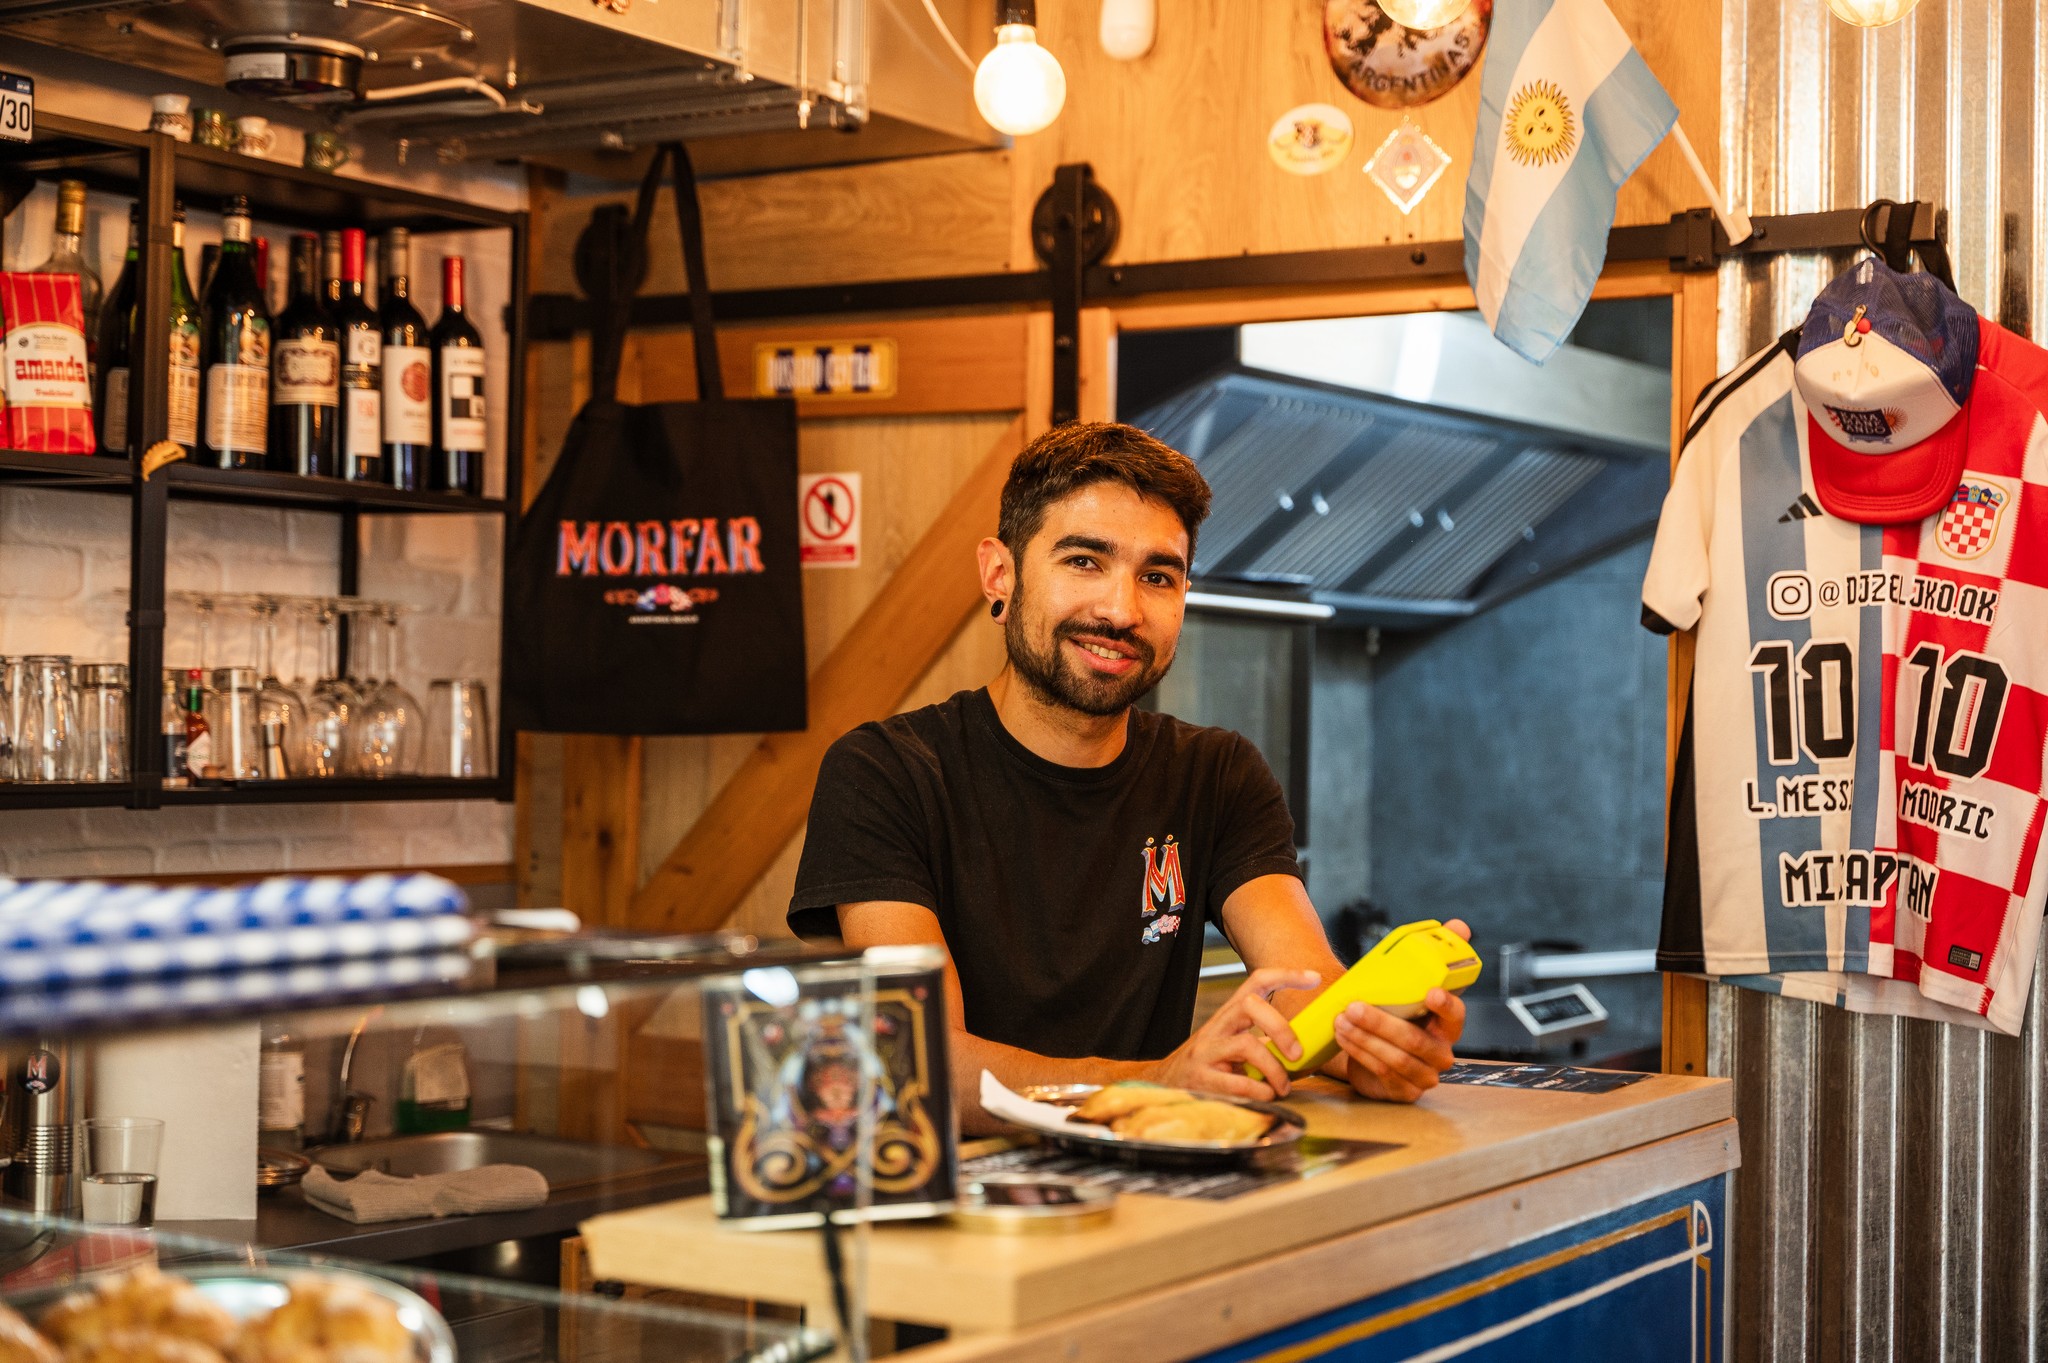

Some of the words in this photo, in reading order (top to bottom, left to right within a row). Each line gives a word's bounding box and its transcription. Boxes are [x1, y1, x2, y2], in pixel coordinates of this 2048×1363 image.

[1350, 27, 1469, 92] ARGENTINAS
[15, 355, 85, 382] amanda
[556, 516, 765, 576] MORFAR
[1751, 642, 1854, 760] 10
[1909, 646, 2008, 779] 10
[1902, 783, 1995, 839] MODRIC
[27, 1055, 49, 1079] M
